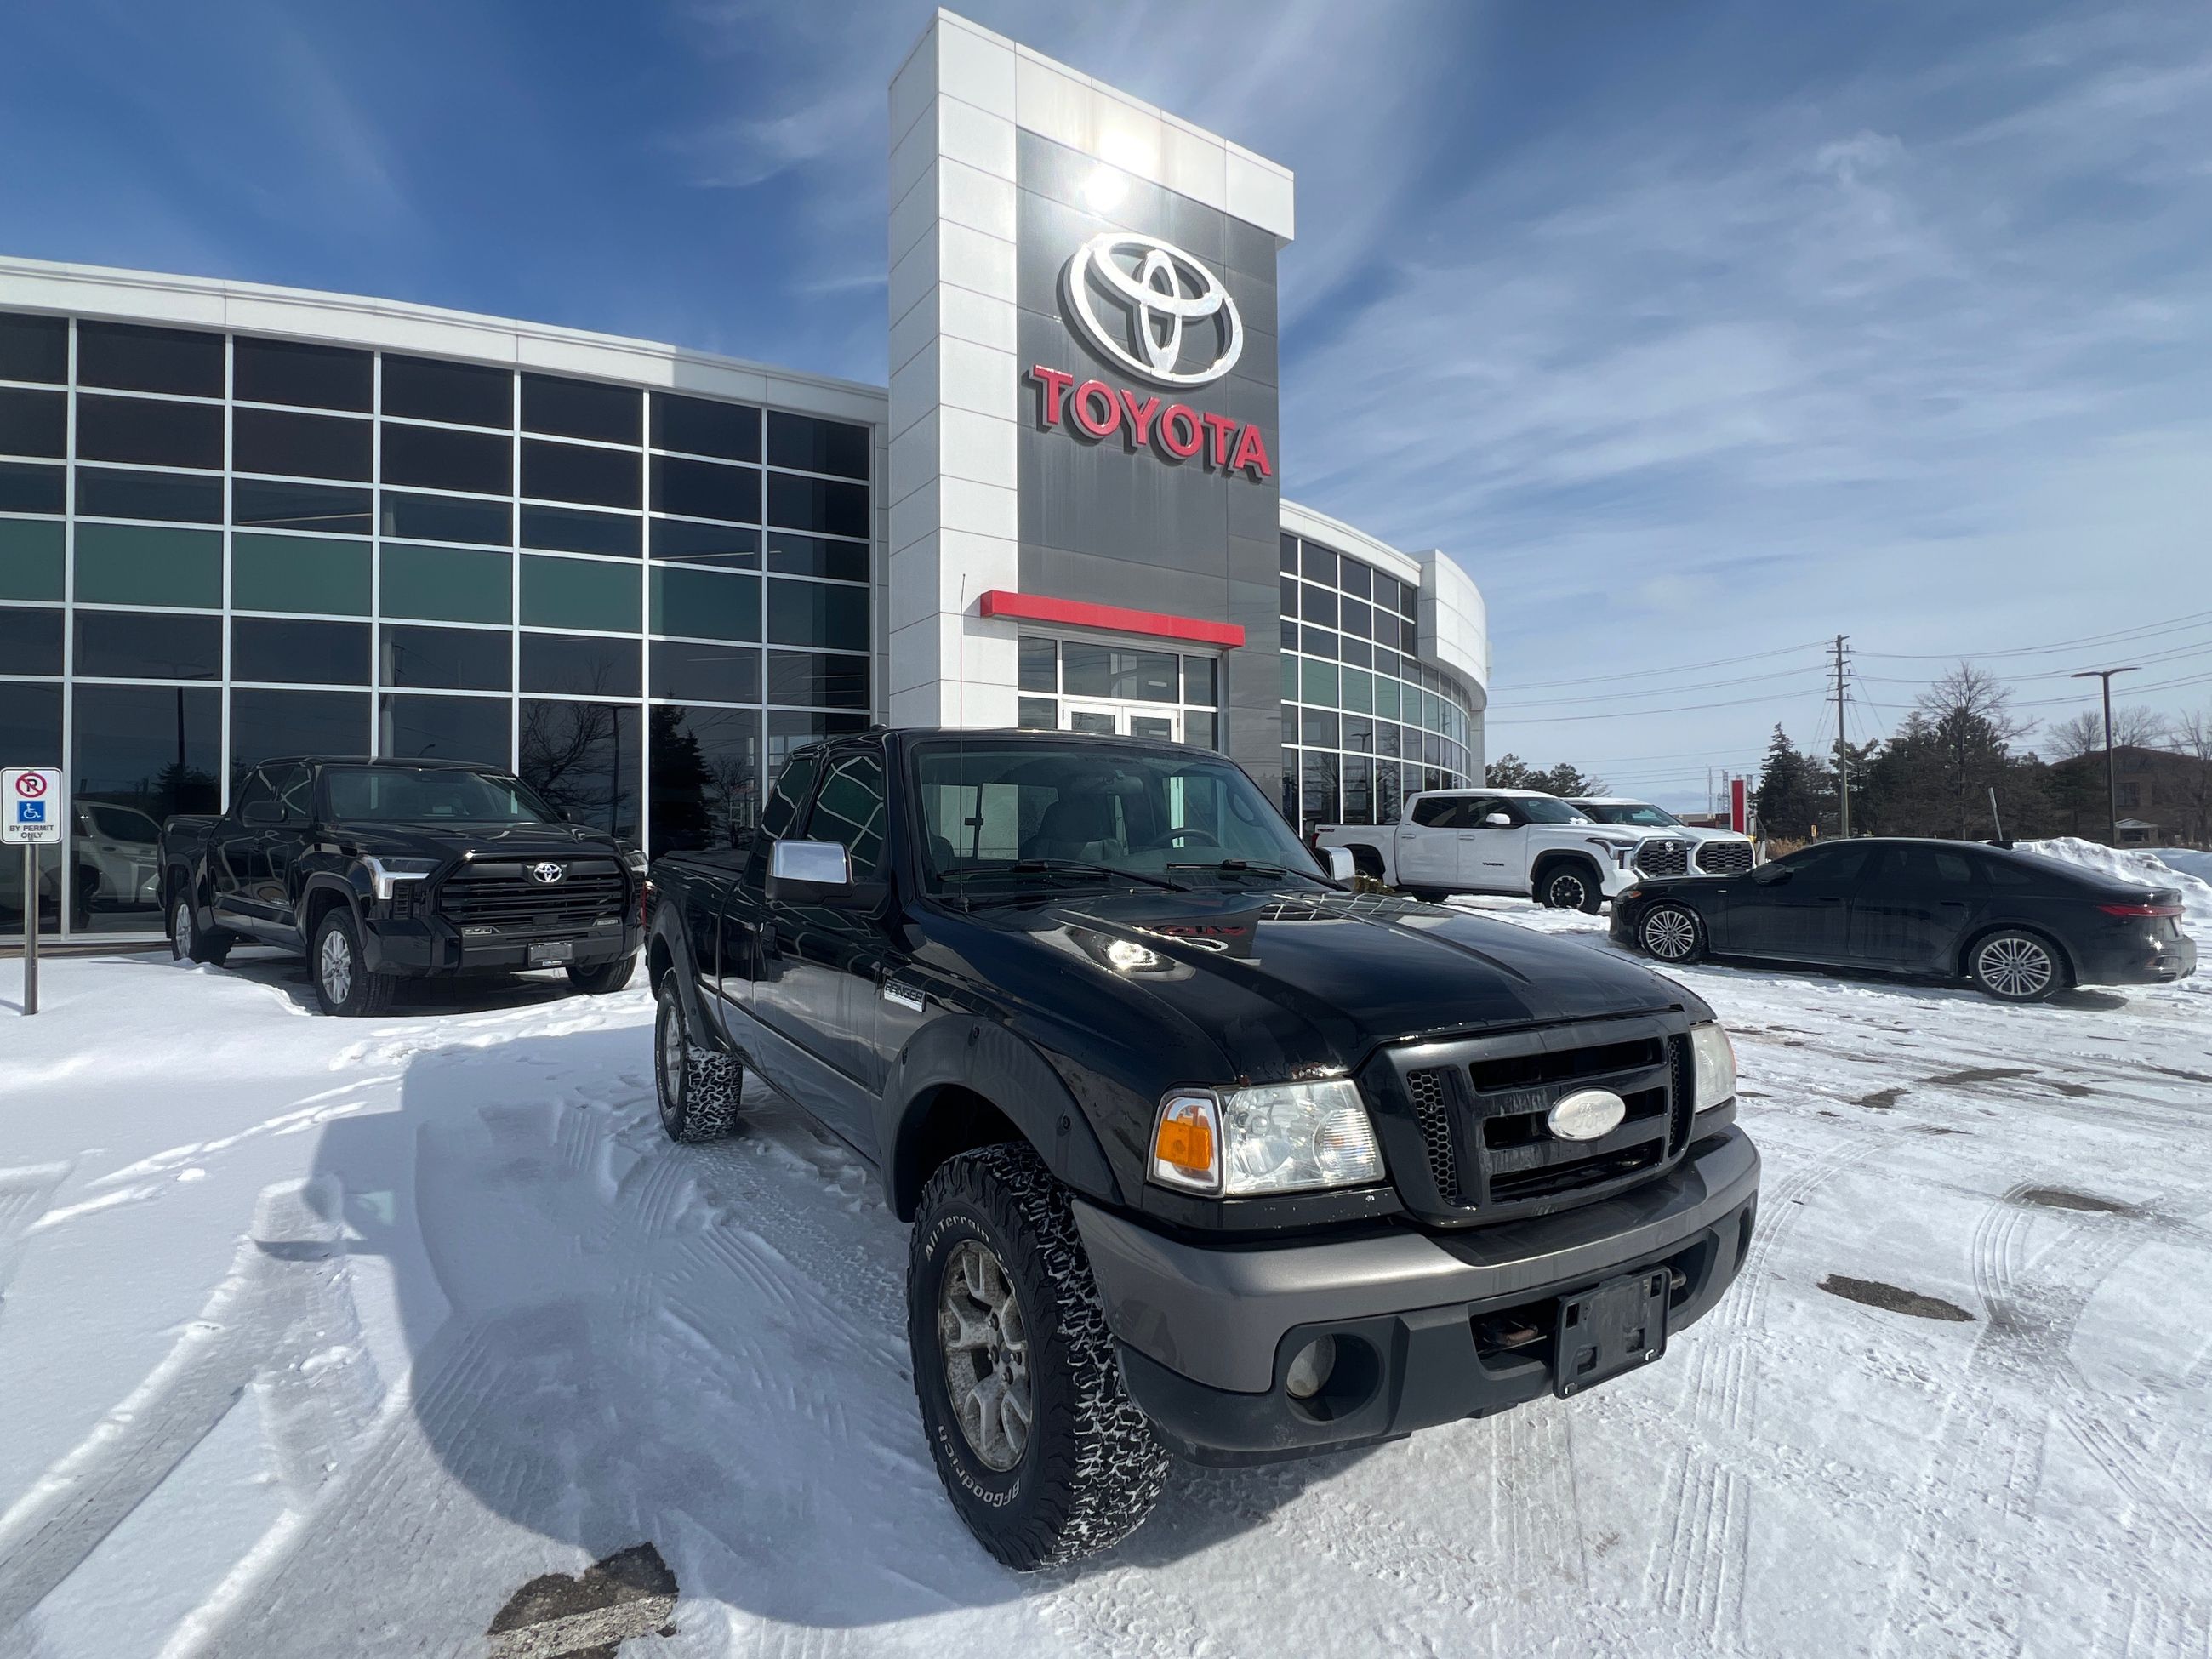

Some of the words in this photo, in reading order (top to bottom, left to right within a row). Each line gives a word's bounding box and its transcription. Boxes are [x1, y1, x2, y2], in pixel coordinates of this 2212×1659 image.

[1029, 363, 1273, 477] TOYOTA
[885, 981, 923, 1004] RANGER
[925, 1214, 990, 1263] All-Terrain
[938, 1424, 1021, 1508] BFGoodrich
